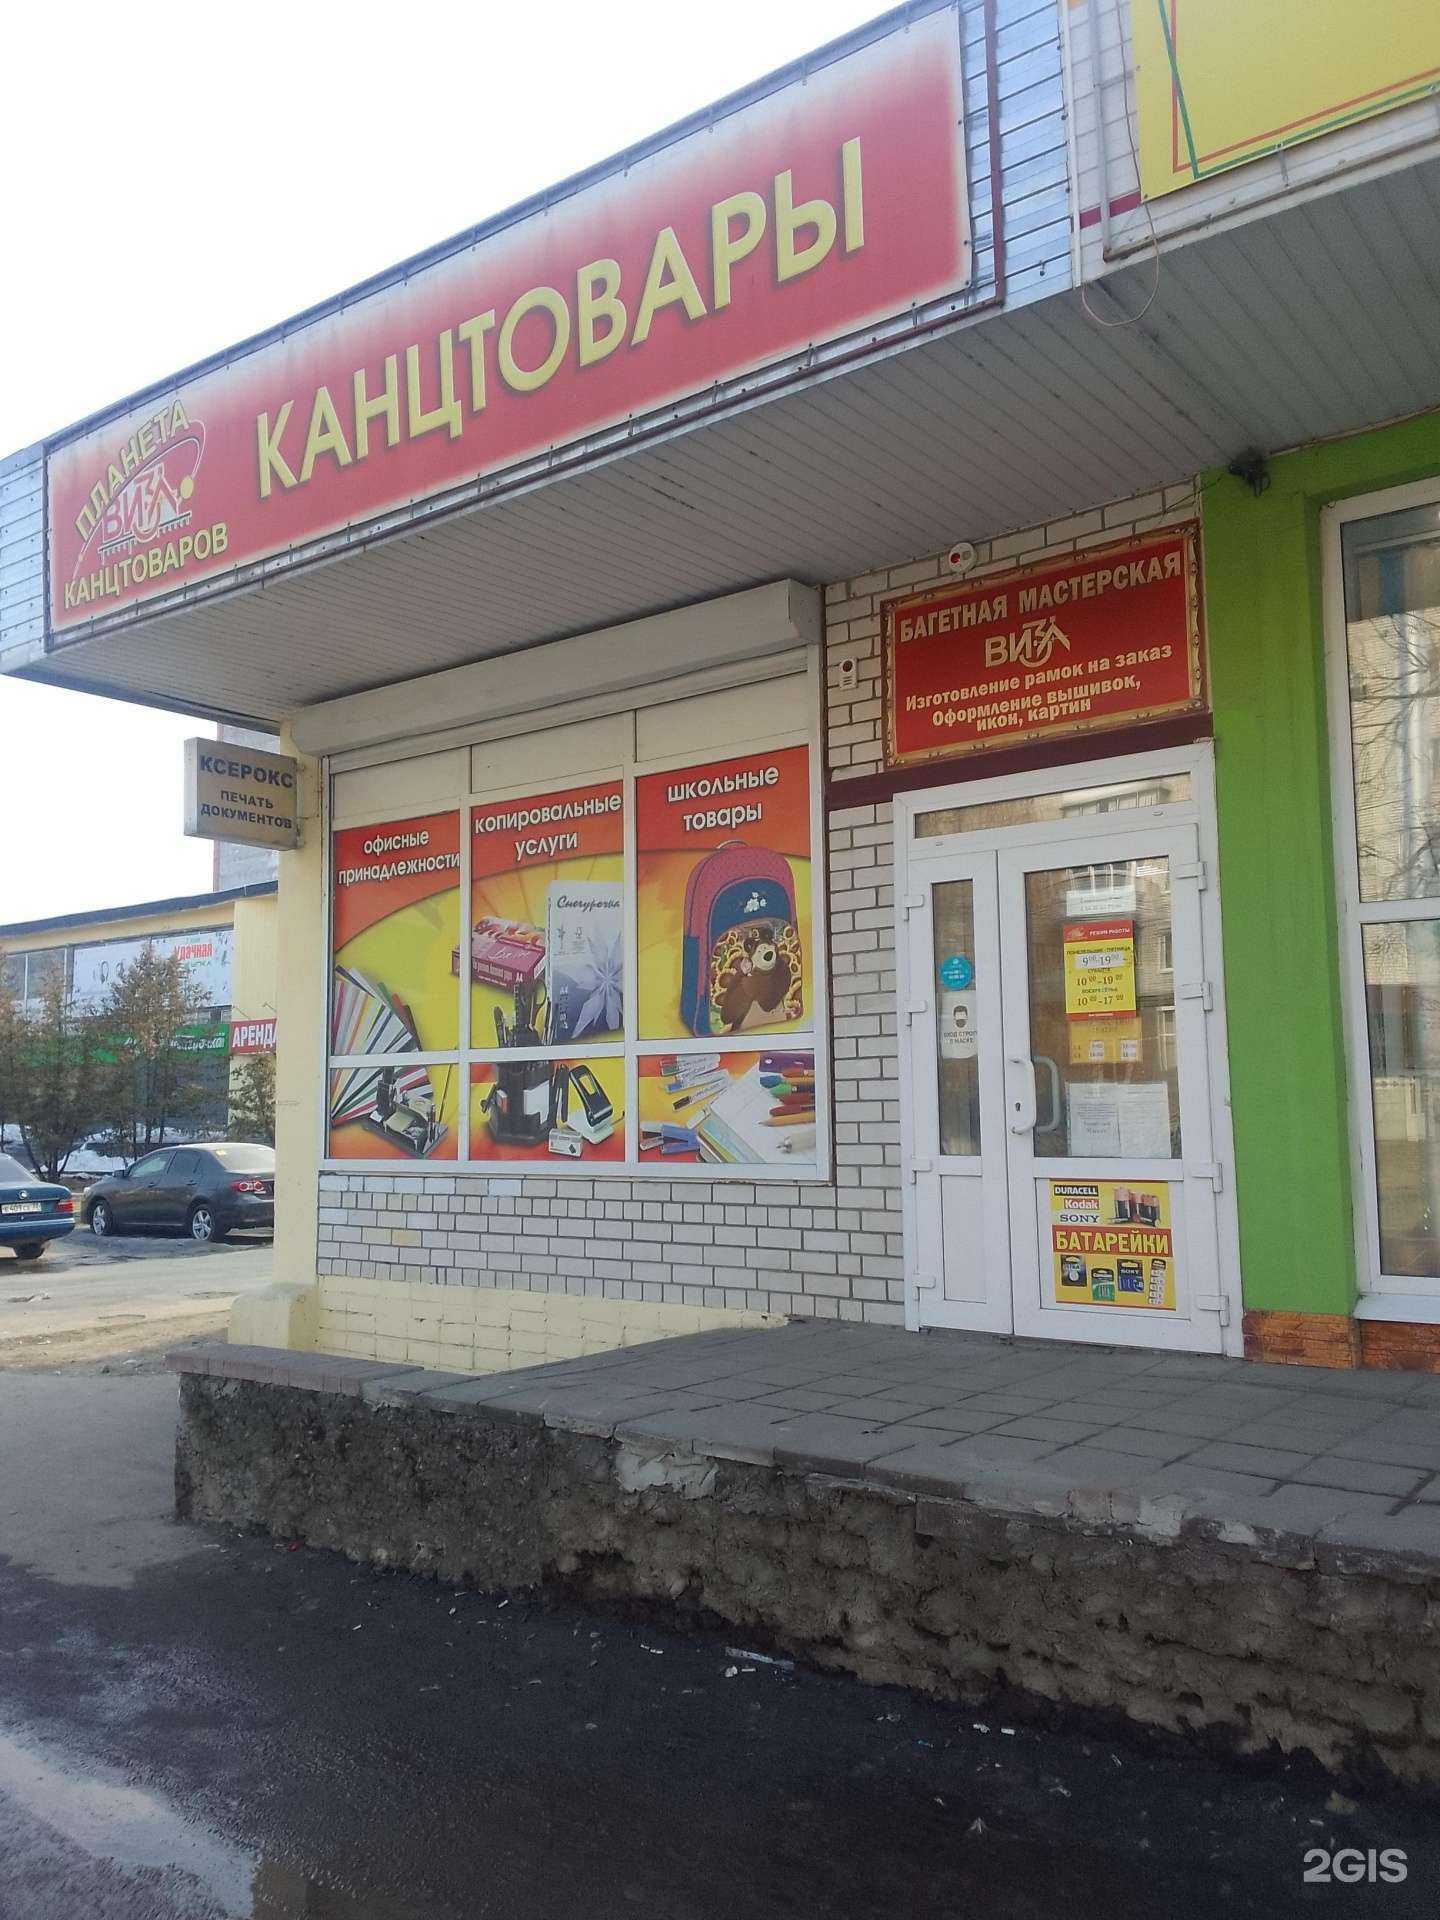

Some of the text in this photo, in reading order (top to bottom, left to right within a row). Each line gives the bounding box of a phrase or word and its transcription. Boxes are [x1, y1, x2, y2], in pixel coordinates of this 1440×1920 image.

[255, 136, 865, 499] КАНЦТОВАРЫ
[74, 399, 191, 541] ПЛАНЕТА
[63, 522, 229, 609] КАНЦТОВАРОВ
[900, 550, 1182, 642] БАГЕТНАЯ МАСТЕРСКАЯ
[906, 644, 1173, 711] Изготовление рамок на заказ
[933, 675, 1142, 727] Оформление вышивок,
[976, 699, 1092, 732] икон, картин
[200, 755, 293, 788] КСЕРОКС
[667, 765, 779, 803] школьные
[200, 803, 292, 829] ДОКУМЕНТОВ
[221, 790, 274, 809] ПЕЧАТЬ
[475, 792, 622, 835] копировальные
[683, 802, 762, 834] товары
[363, 829, 430, 856] офисные
[514, 831, 578, 861] услуги
[338, 851, 460, 887] принадлежности
[556, 895, 621, 912] Снегурочка
[1055, 1186, 1098, 1196] DURACELL
[1064, 1198, 1099, 1209] Kodak
[1060, 1214, 1100, 1223] SONY
[1055, 1228, 1169, 1255] БАТАРЕЙКИ
